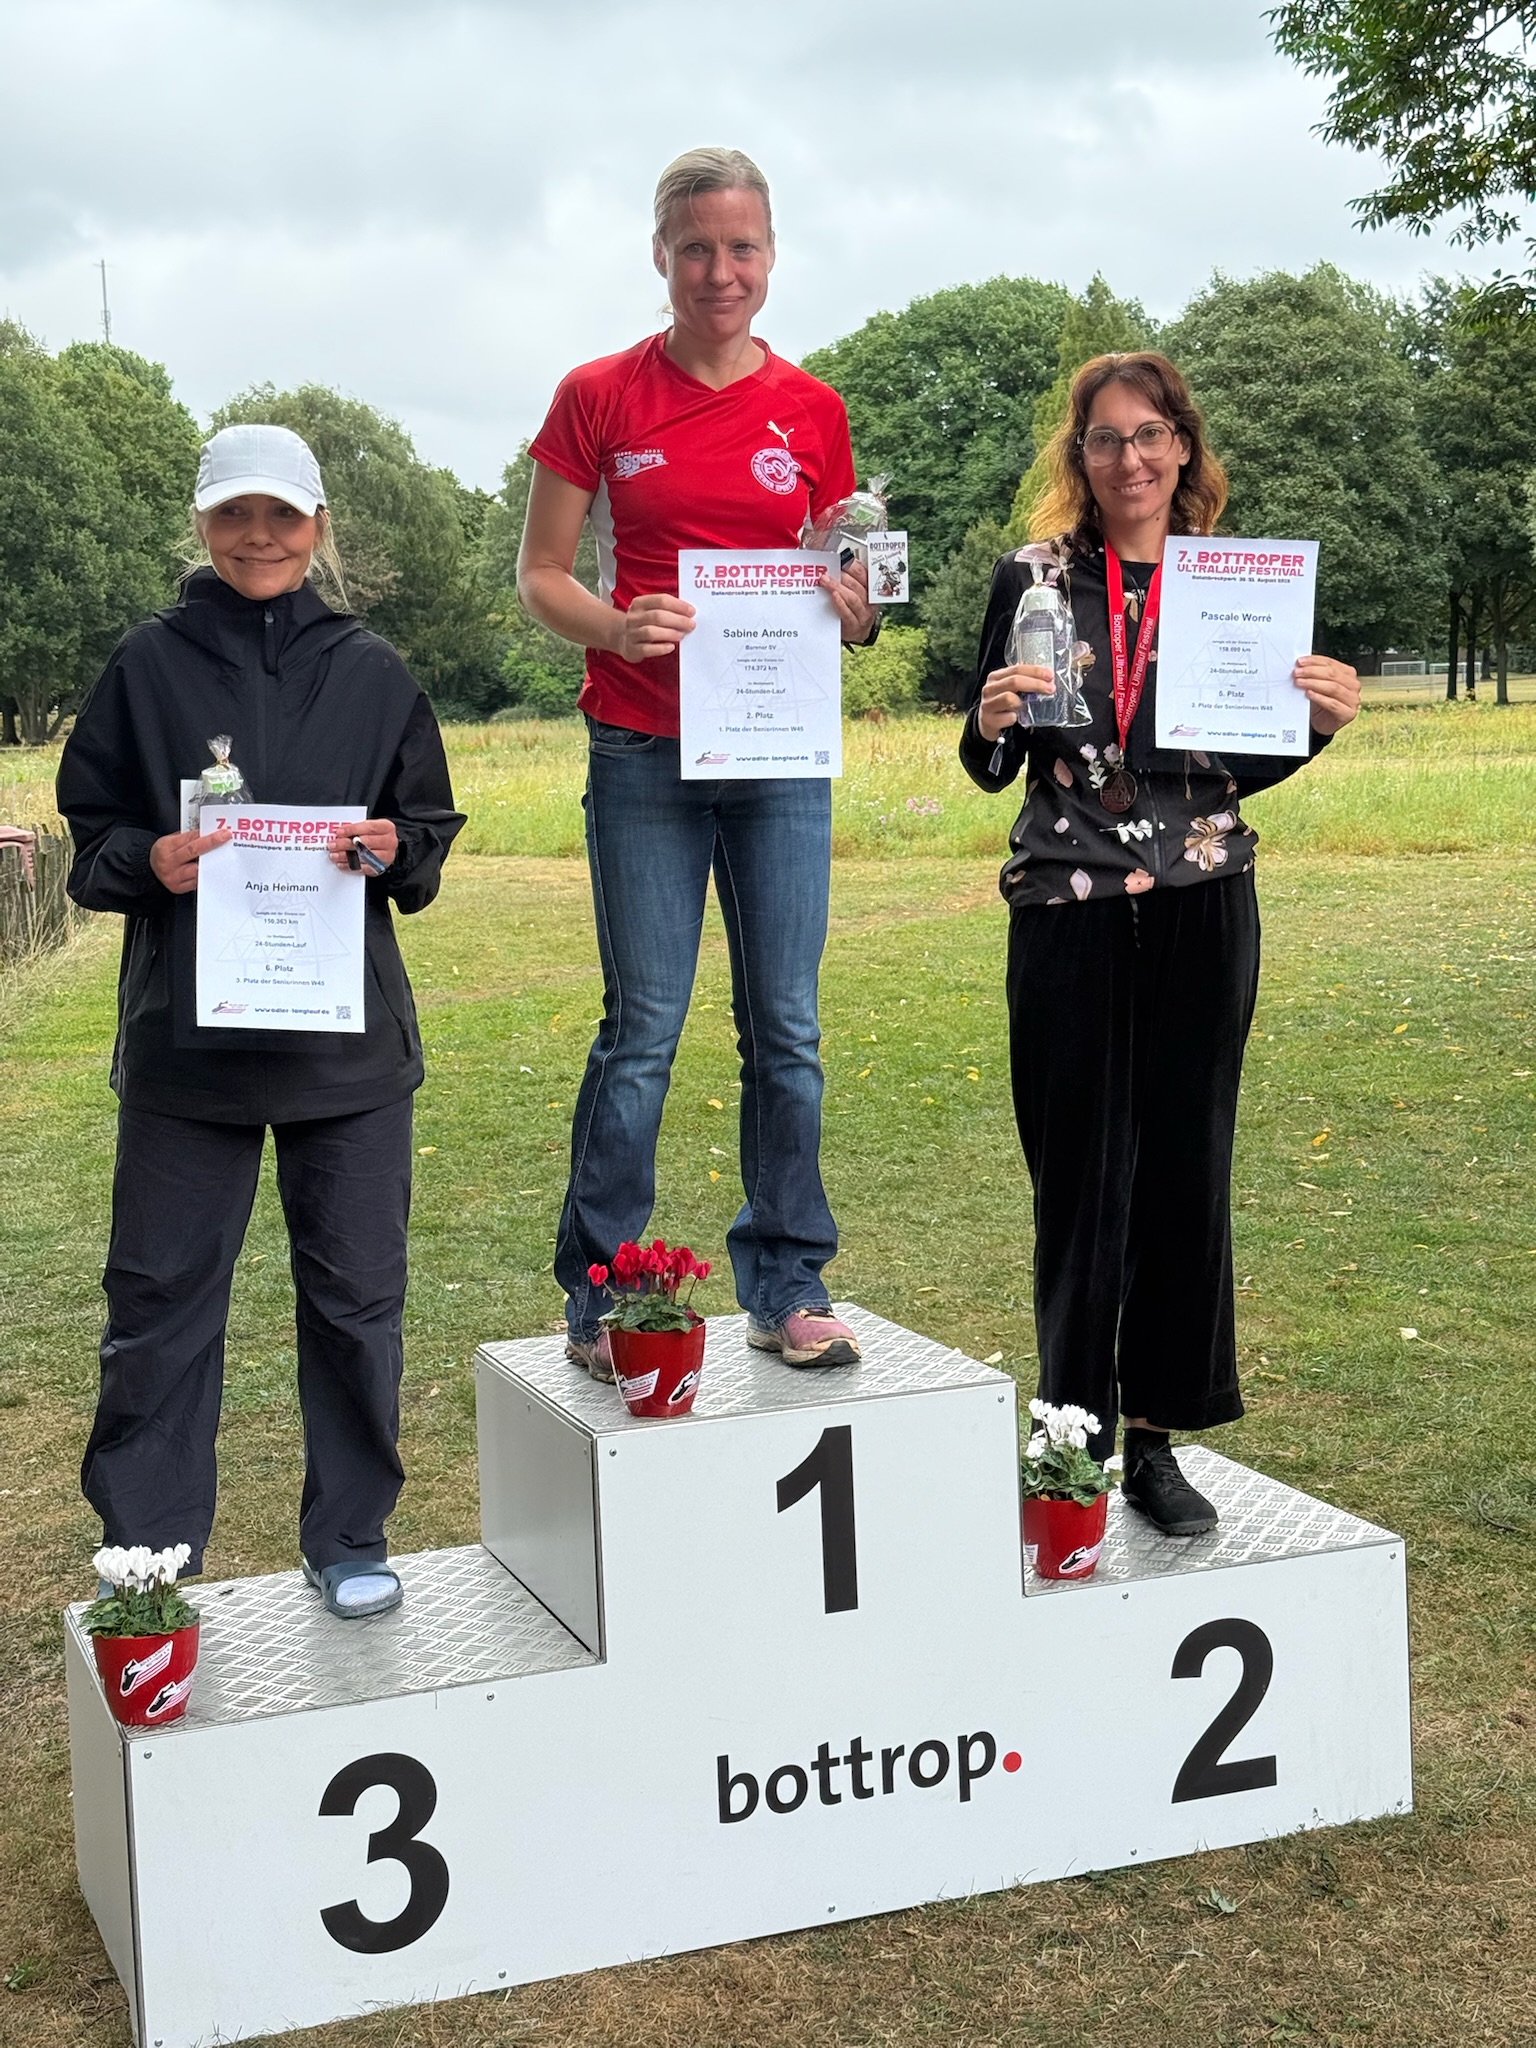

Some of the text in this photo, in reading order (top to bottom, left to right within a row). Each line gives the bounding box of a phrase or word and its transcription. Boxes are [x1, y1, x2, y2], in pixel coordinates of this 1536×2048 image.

[1178, 551, 1305, 567] 7. BOTTROPER
[694, 565, 828, 579] 7. BOTTROPER
[1177, 564, 1305, 577] ULTRALAUF FESTIVAL
[694, 578, 821, 589] ULTRALAUF FESTIVA
[1201, 611, 1272, 623] Pascale Worré
[723, 628, 799, 638] Sabine Andres
[1114, 614, 1123, 653] Bottroper
[1139, 617, 1154, 651] Festival
[1116, 654, 1126, 691] Ultralauf
[1132, 650, 1147, 688] Ultralauf
[1226, 690, 1245, 698] Platz
[216, 818, 352, 835] 7. BOTTROPE
[230, 831, 291, 844] TRALAUF
[245, 881, 319, 893] Anja Heimann
[265, 964, 294, 973] 6. Platz
[776, 1423, 859, 1615] 1
[1170, 1617, 1278, 1804] 2
[317, 1752, 450, 1955] 3
